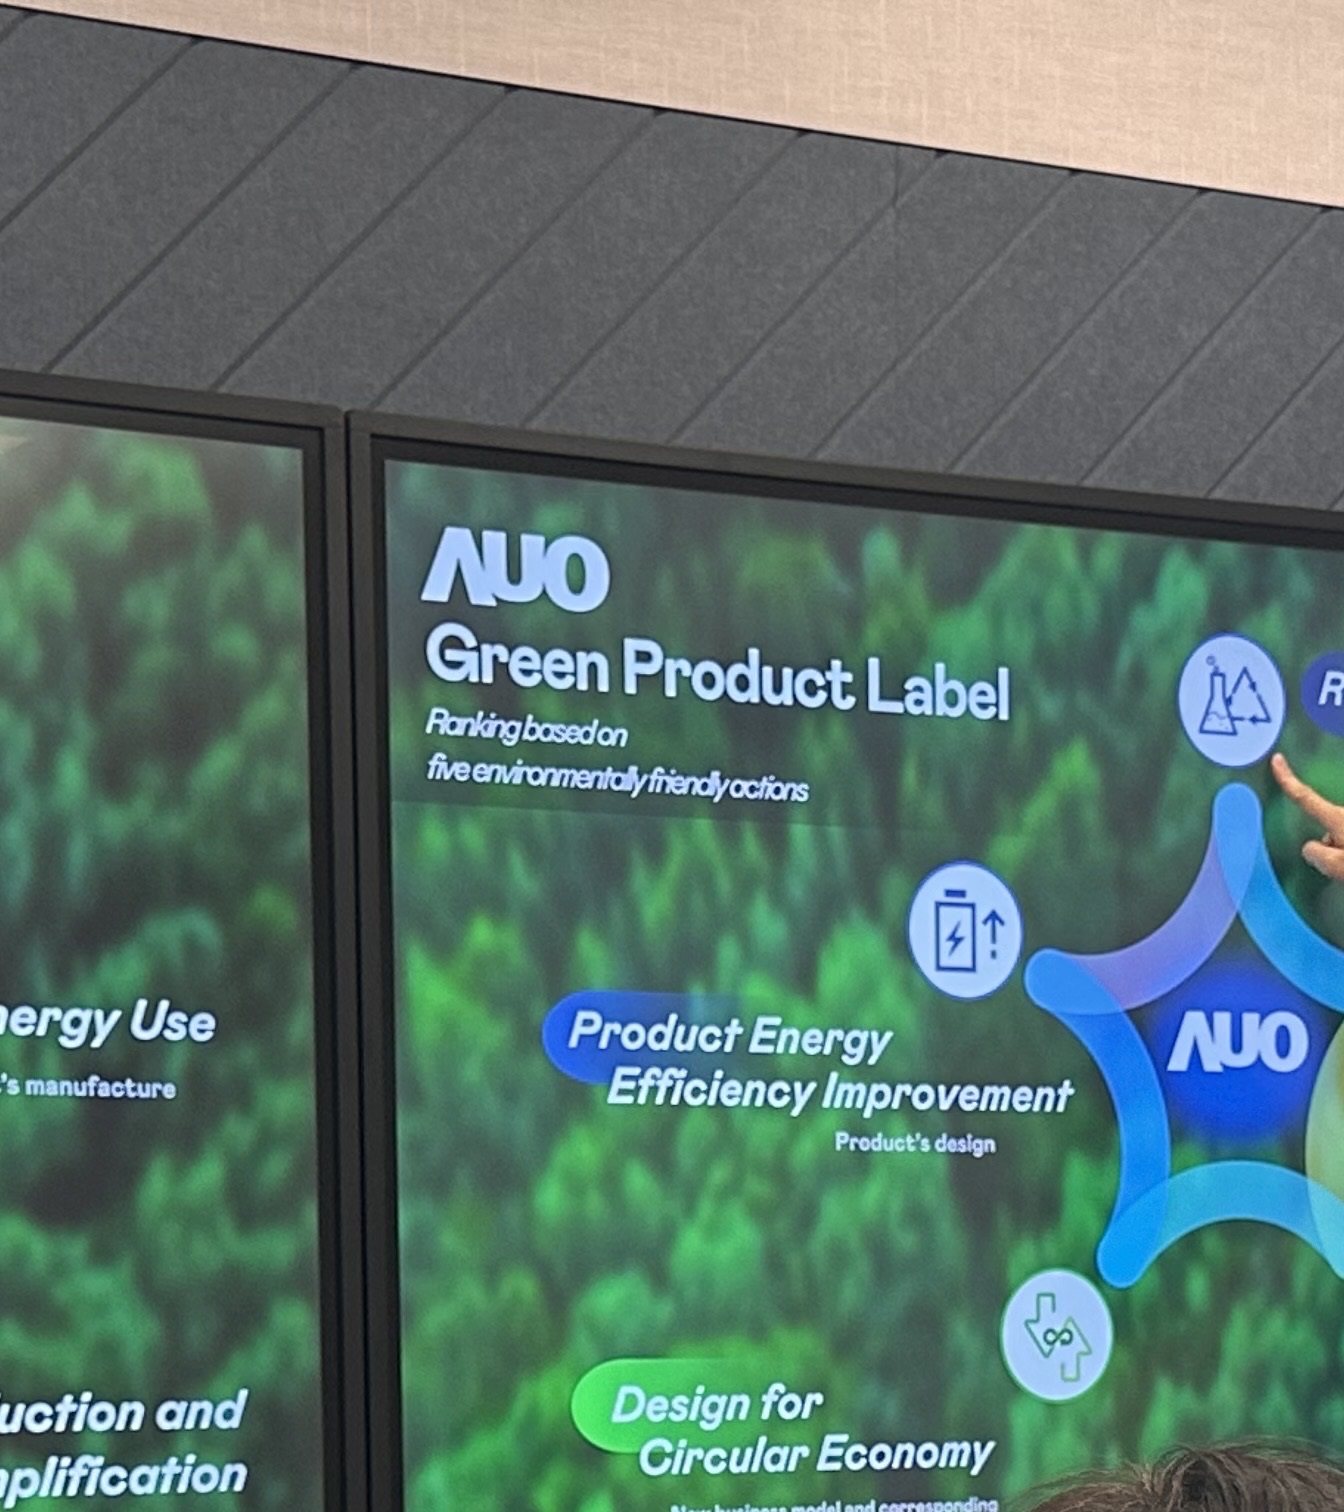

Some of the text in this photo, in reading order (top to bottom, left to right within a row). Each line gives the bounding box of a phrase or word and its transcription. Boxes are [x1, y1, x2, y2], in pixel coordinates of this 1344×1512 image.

[420, 526, 610, 612] AUO
[424, 622, 1010, 721] Green Product Label
[425, 707, 628, 748] Ranking based on
[427, 752, 809, 803] five environmentally friendly actions
[130, 998, 216, 1043] Use
[568, 1010, 893, 1065] Product Energy
[1167, 1009, 1309, 1073] AUO
[26, 1074, 176, 1100] manufacture
[606, 1067, 1074, 1119] Efficiency Improvement
[835, 1132, 996, 1158] Product's design
[156, 1388, 249, 1431] and
[611, 1383, 824, 1431] Design for
[639, 1433, 996, 1477] Circular Economy
